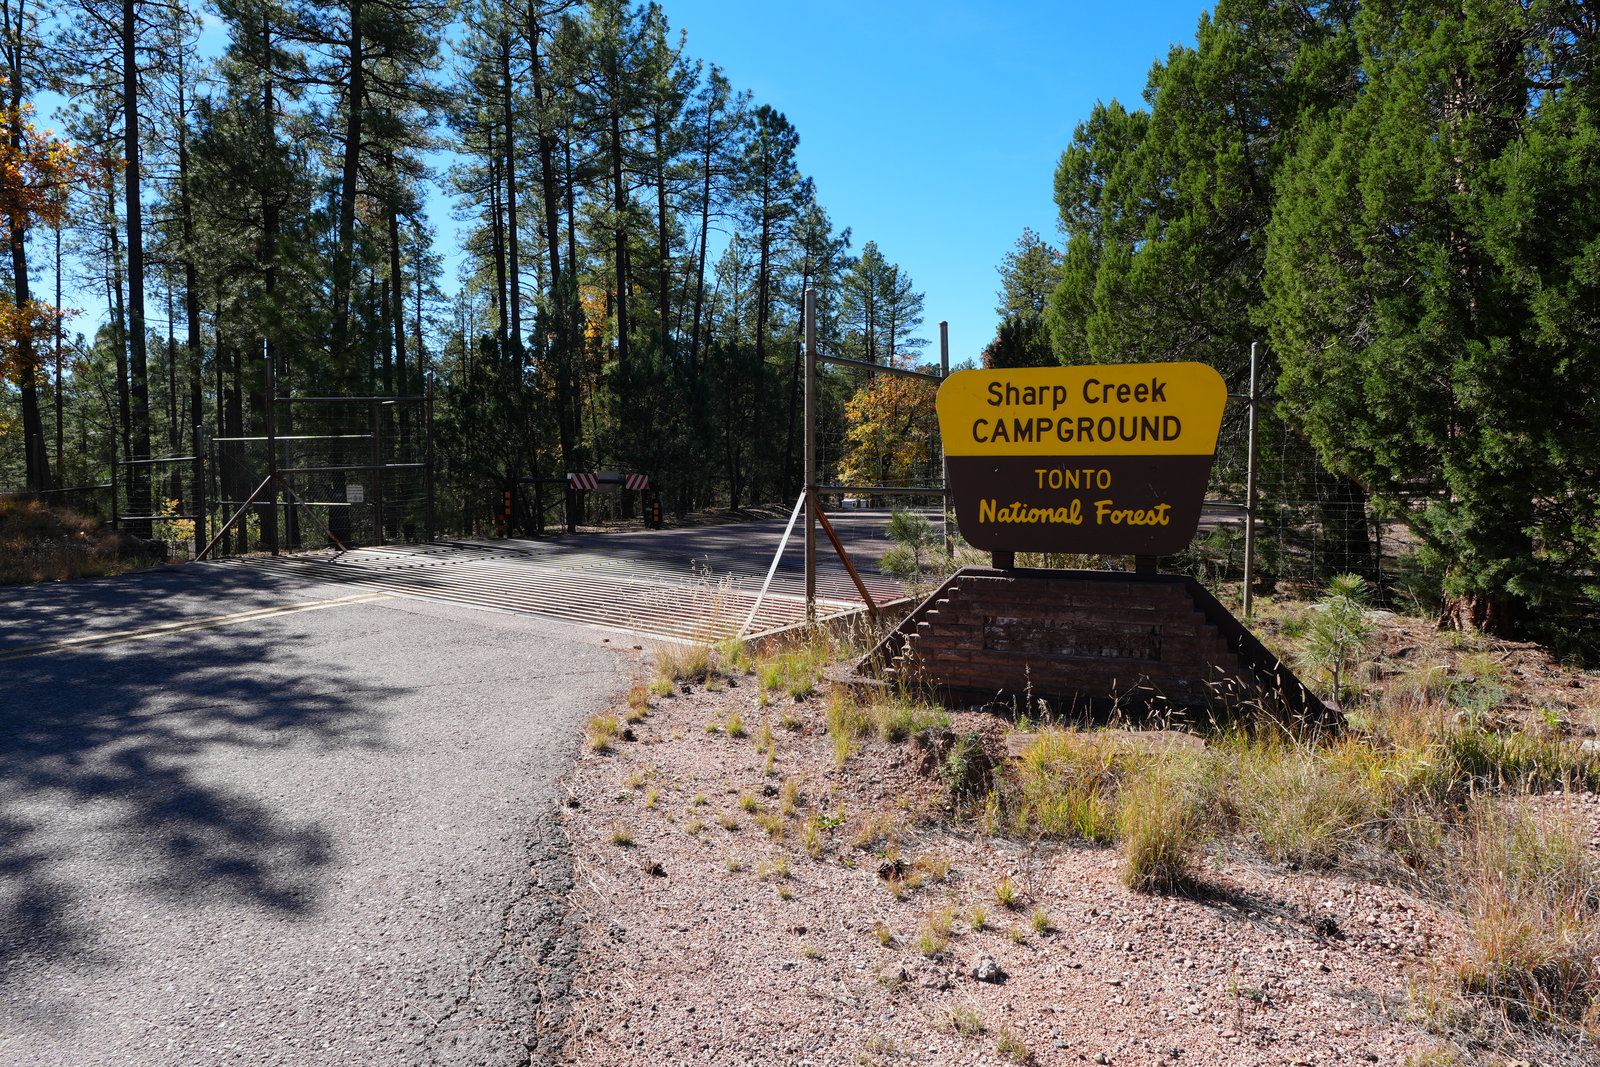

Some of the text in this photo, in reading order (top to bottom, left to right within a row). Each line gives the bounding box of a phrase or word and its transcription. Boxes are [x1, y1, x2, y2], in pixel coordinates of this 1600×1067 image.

[987, 377, 1167, 411] Sharp Creek
[972, 415, 1182, 443] CAMPGROUND
[1034, 469, 1112, 490] TONTO
[979, 498, 1171, 526] National Forest
